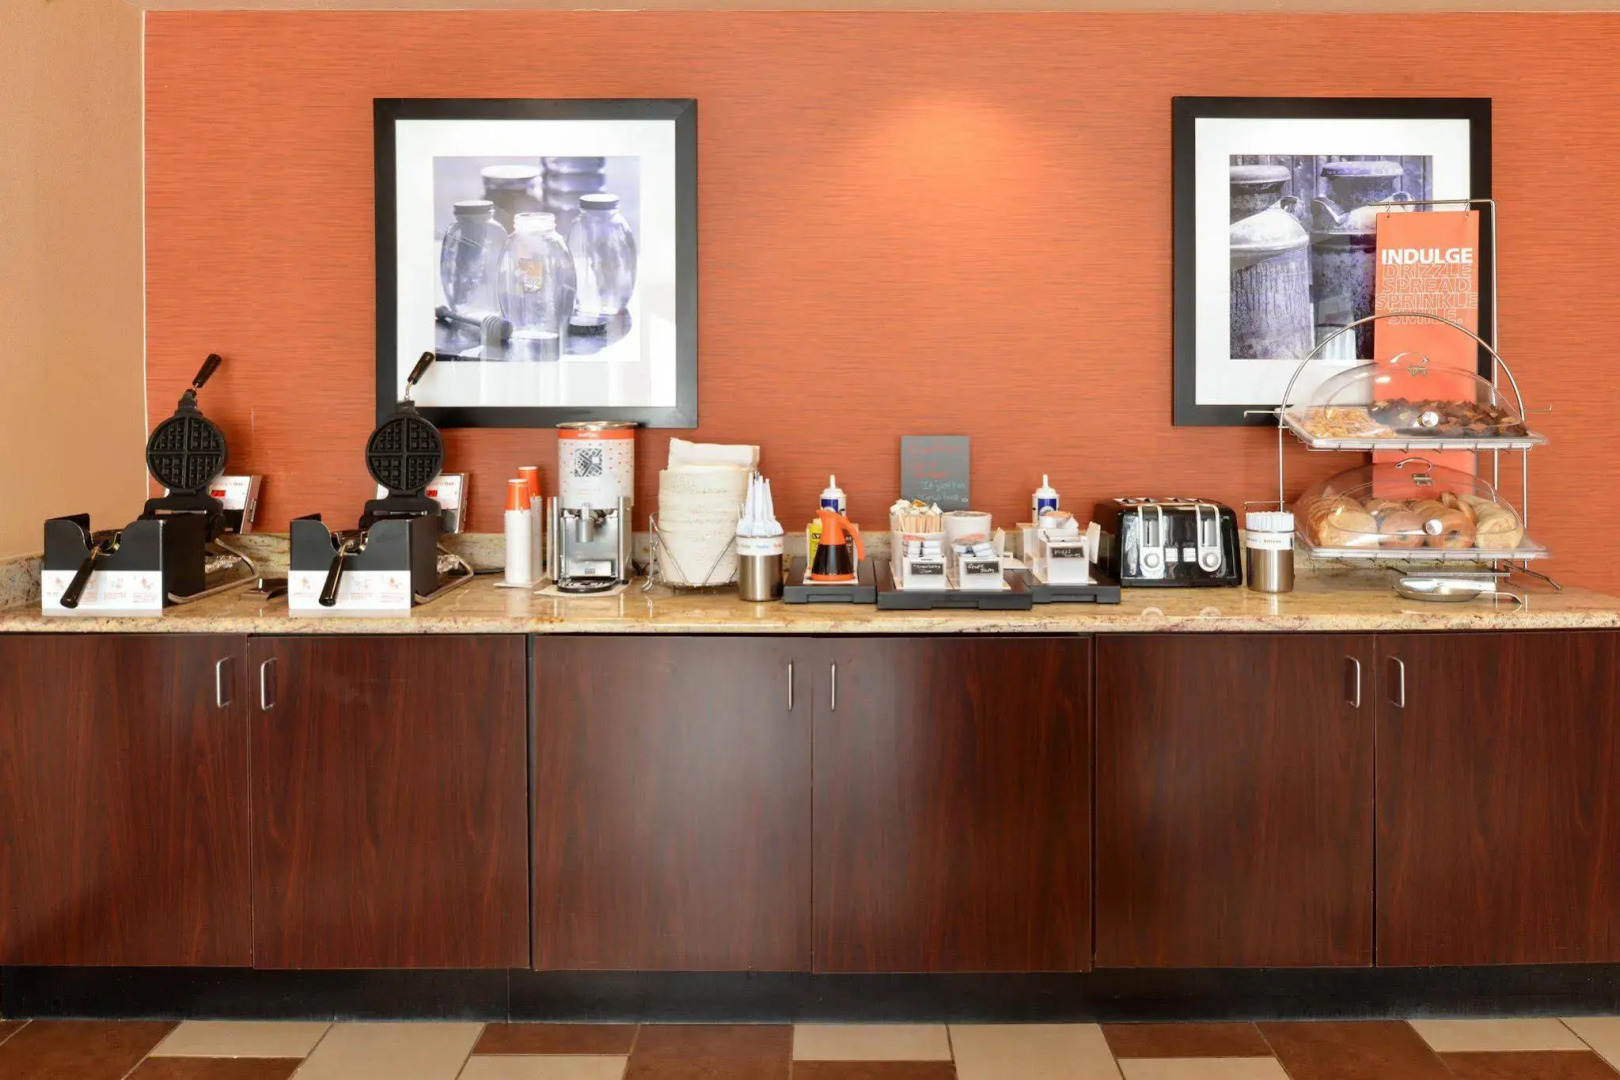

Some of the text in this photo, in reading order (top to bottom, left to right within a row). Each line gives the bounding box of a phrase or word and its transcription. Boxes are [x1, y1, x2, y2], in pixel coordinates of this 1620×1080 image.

[1381, 248, 1473, 265] INDULGE
[1383, 264, 1473, 279] DRIZZLE
[1382, 278, 1473, 294] SPREAD
[1375, 292, 1478, 310] SPRINKLE
